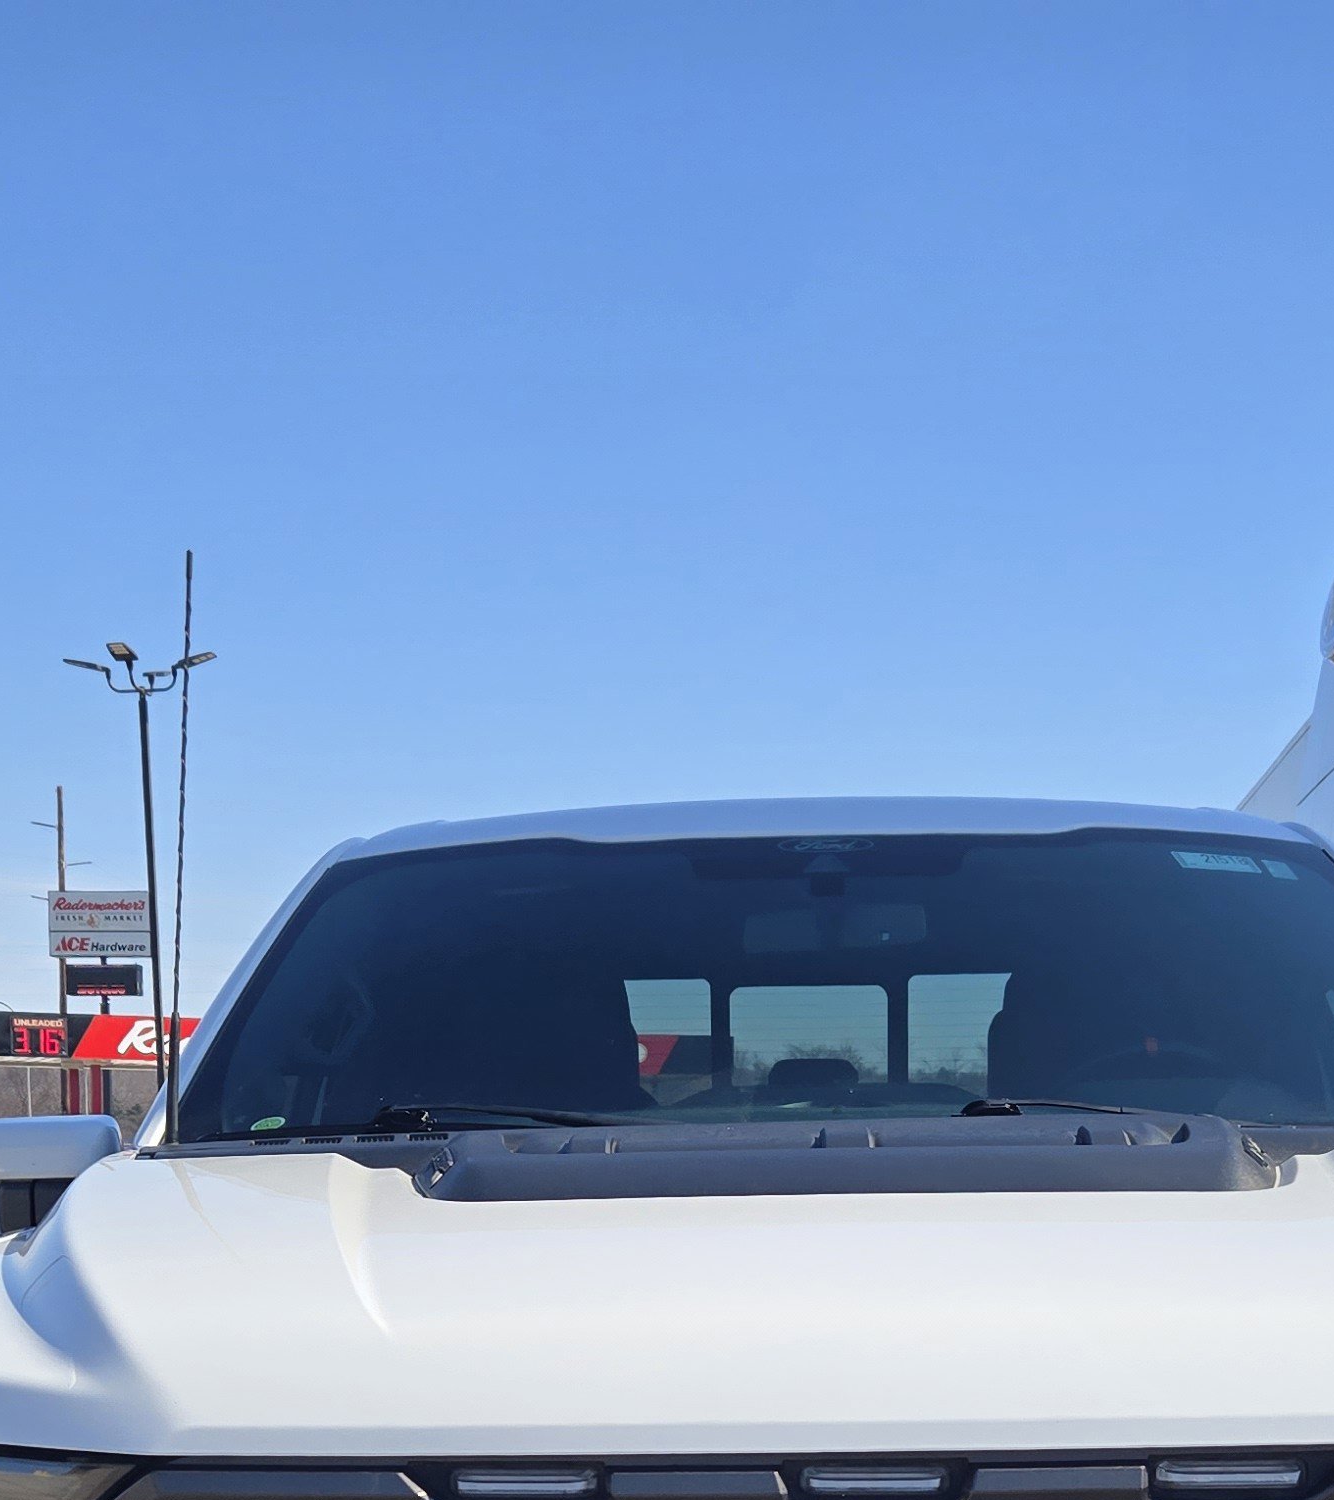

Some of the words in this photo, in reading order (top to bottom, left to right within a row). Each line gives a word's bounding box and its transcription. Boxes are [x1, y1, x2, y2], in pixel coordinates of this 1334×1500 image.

[55, 936, 90, 951] ACE
[90, 942, 146, 952] Hardware
[13, 1018, 64, 1027] UNLEADED
